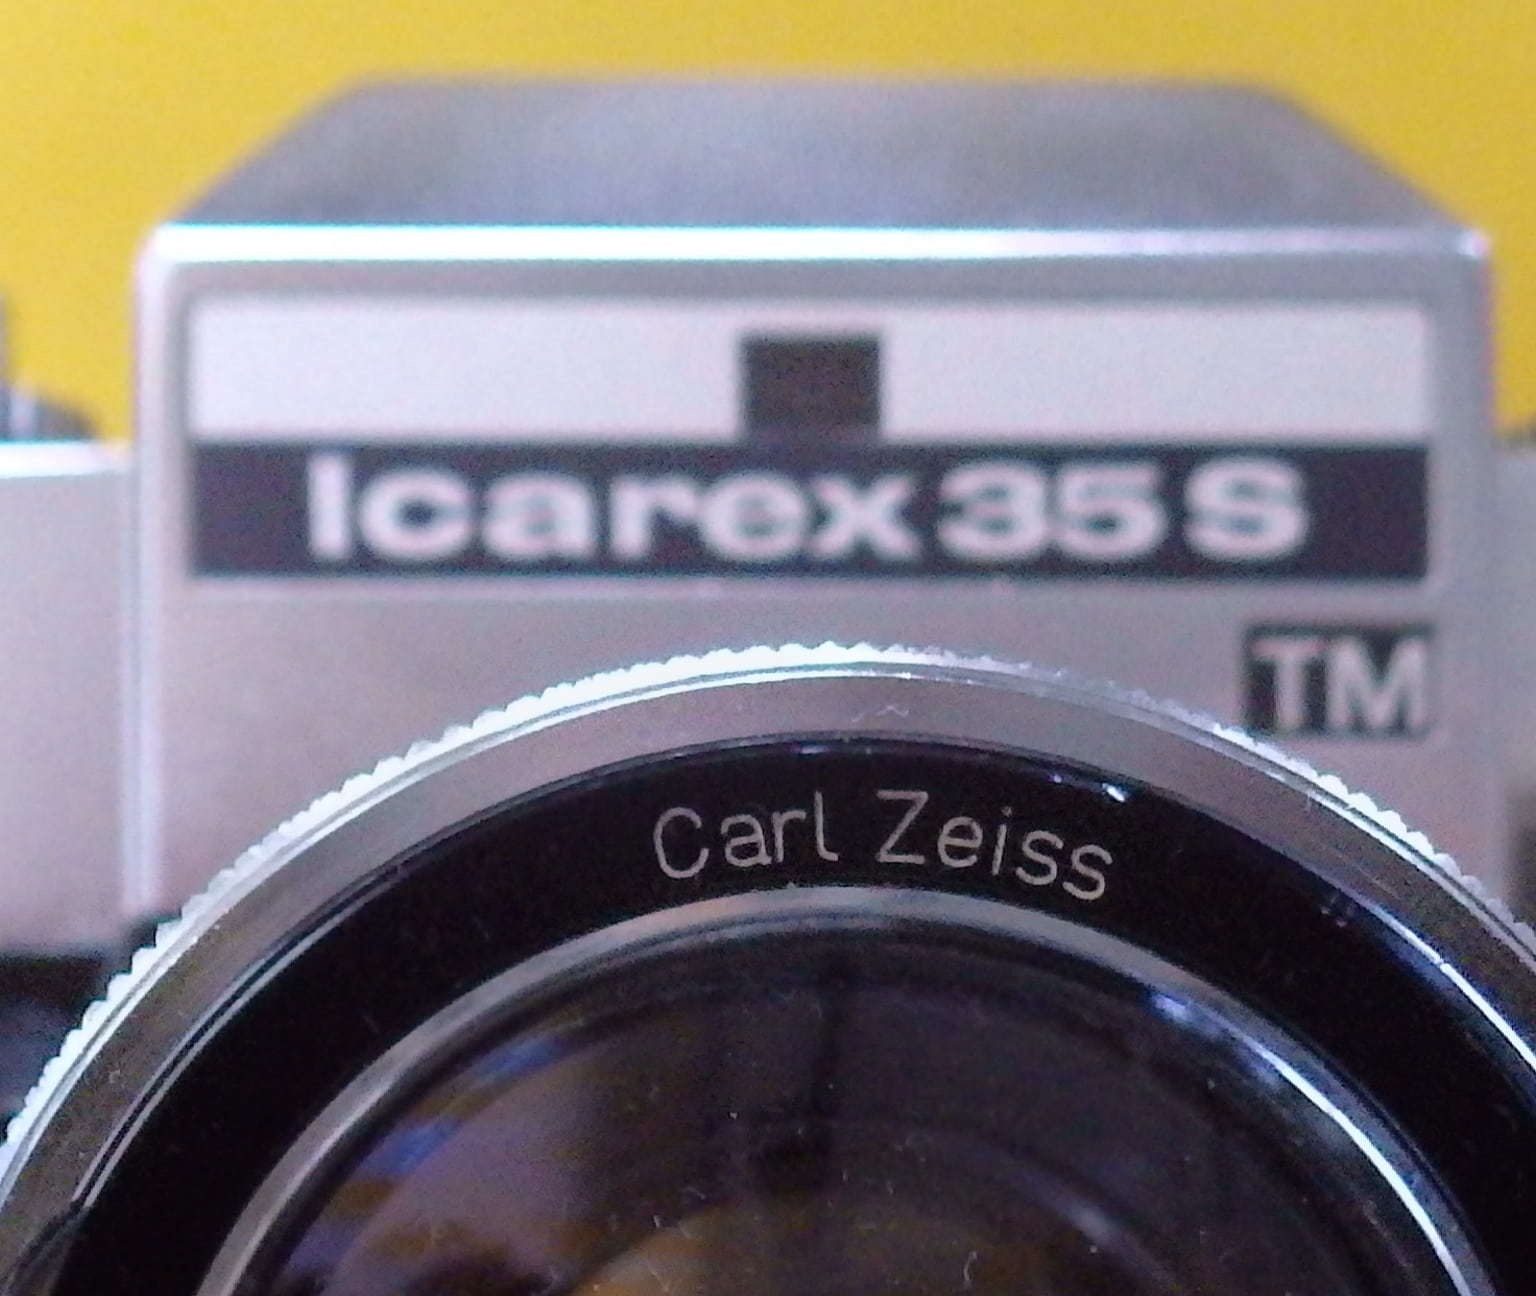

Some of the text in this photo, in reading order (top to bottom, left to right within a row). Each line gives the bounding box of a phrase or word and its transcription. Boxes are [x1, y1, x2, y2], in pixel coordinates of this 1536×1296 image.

[306, 452, 918, 565] Icarex
[1256, 638, 1428, 735] TM
[650, 789, 1114, 901] Carl Zeiss
